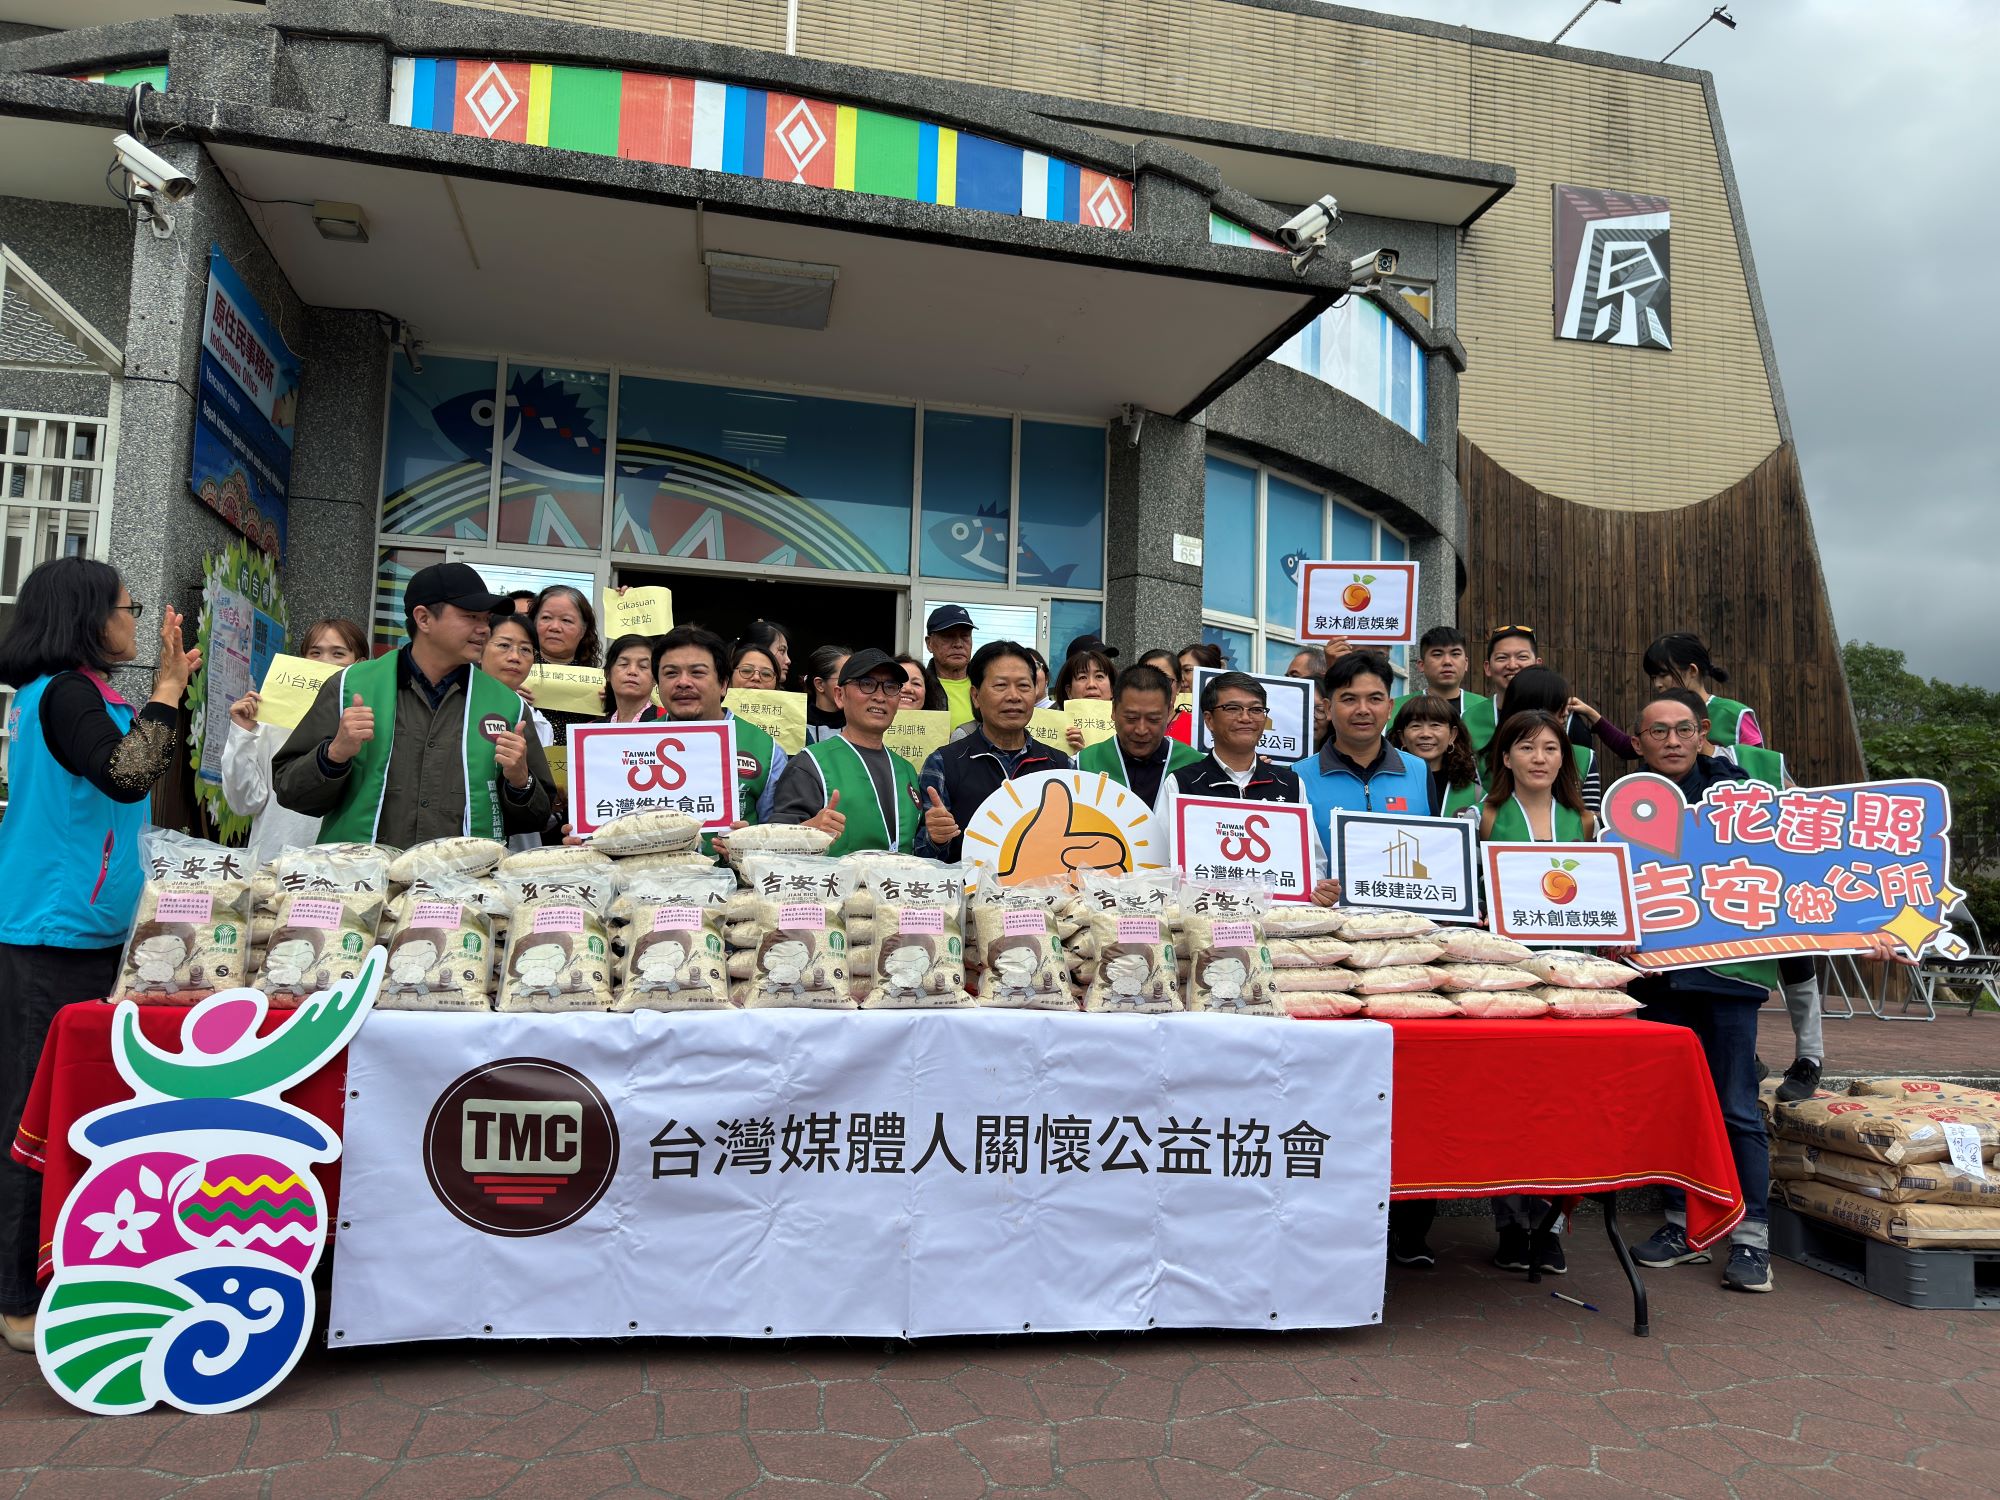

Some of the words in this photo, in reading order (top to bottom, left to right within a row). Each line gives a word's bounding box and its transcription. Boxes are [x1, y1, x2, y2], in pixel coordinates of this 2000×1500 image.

[213, 290, 274, 393] 原住民事務所
[209, 328, 241, 377] Indigenous
[242, 368, 258, 397] Office
[1181, 547, 1196, 562] 65
[617, 599, 656, 611] Cikasuan
[620, 614, 652, 627] 文健站
[1314, 615, 1399, 631] 泉沐創意娛樂
[740, 703, 782, 716] 博愛新村
[486, 722, 506, 732] TMC
[623, 750, 656, 758] TAIWAN
[1216, 822, 1244, 830] TAIWAN
[1708, 786, 1925, 854] 花蓮縣
[152, 853, 244, 881] 吉安米
[762, 871, 841, 897] 吉安米
[1354, 880, 1457, 903] 秉俊建設公司
[1638, 859, 1933, 930] 吉安鄉公所
[1512, 909, 1618, 929] 泉沐創意娛樂
[466, 1110, 579, 1163] TMC
[648, 1111, 1332, 1179] 台灣媒體人關懷公益協會
